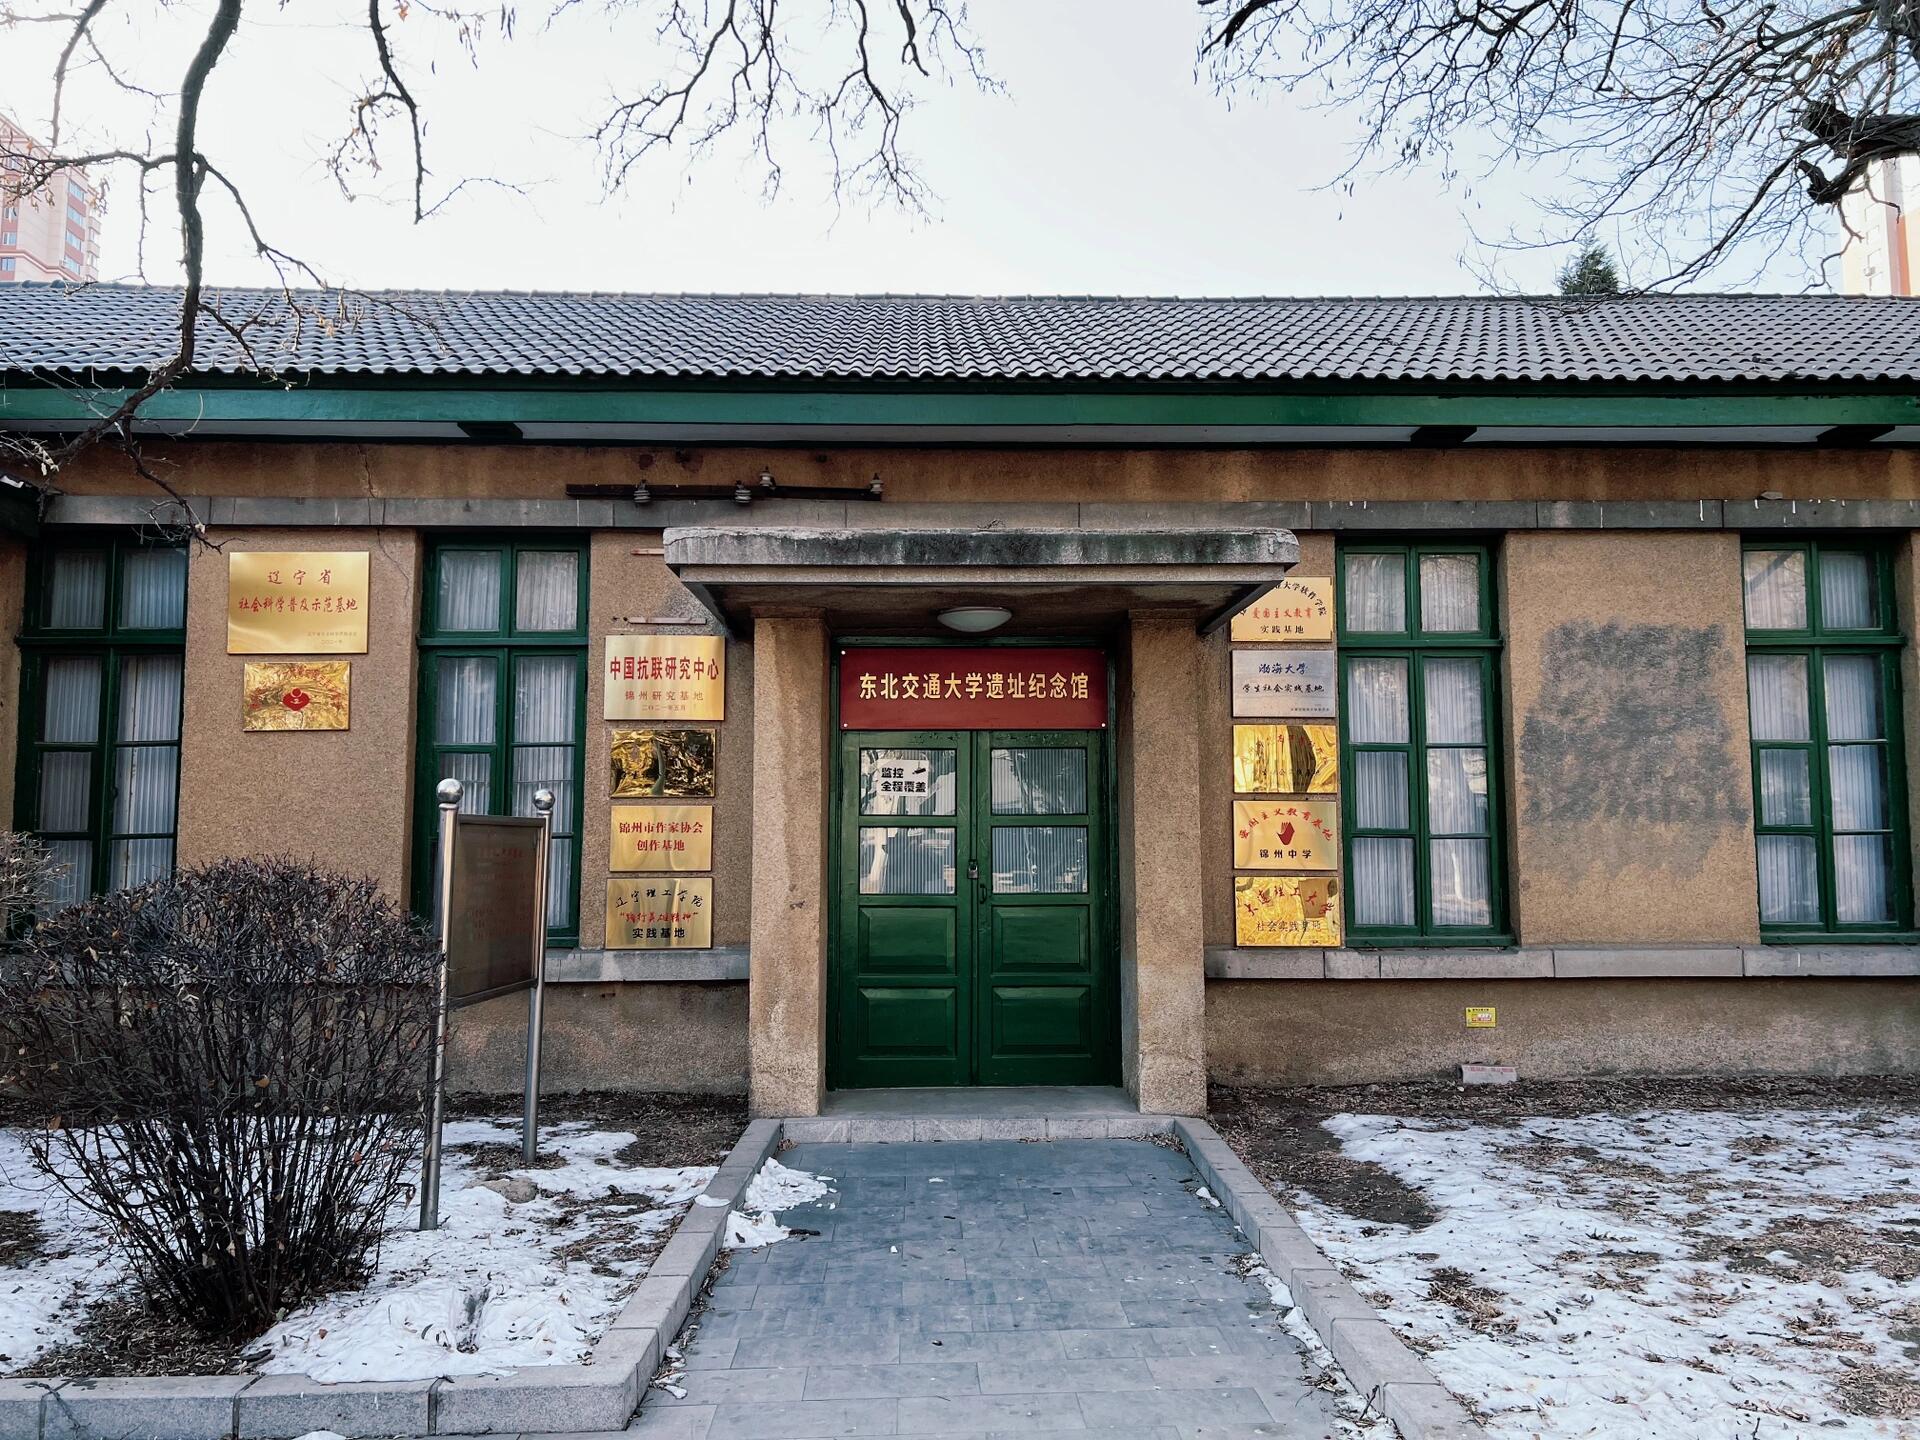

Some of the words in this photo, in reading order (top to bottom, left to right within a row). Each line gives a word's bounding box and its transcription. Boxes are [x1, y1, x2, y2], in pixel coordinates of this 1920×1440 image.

[267, 569, 332, 586] 辽宁省
[238, 596, 358, 613] 社会科学普及示范基地
[1251, 606, 1313, 619] 爱国主义教育
[1260, 625, 1305, 635] 实践基地
[610, 656, 719, 681] 中国抗联研究中心
[859, 672, 1090, 700] 东北交通大学遗址纪念馆
[1242, 683, 1324, 694] 学生社会实践基地
[625, 690, 705, 702] 锦州研究基地
[880, 767, 904, 779] 监控
[880, 780, 926, 793] 全程覆盖
[619, 821, 703, 834] 锦州市作家协会
[1239, 807, 1333, 842] 爱国主义教育基地
[636, 839, 685, 852] 创作基地
[1259, 849, 1312, 859] 锦州中学
[615, 888, 703, 908] 辽宁理工学院
[632, 927, 685, 939] 实践基地
